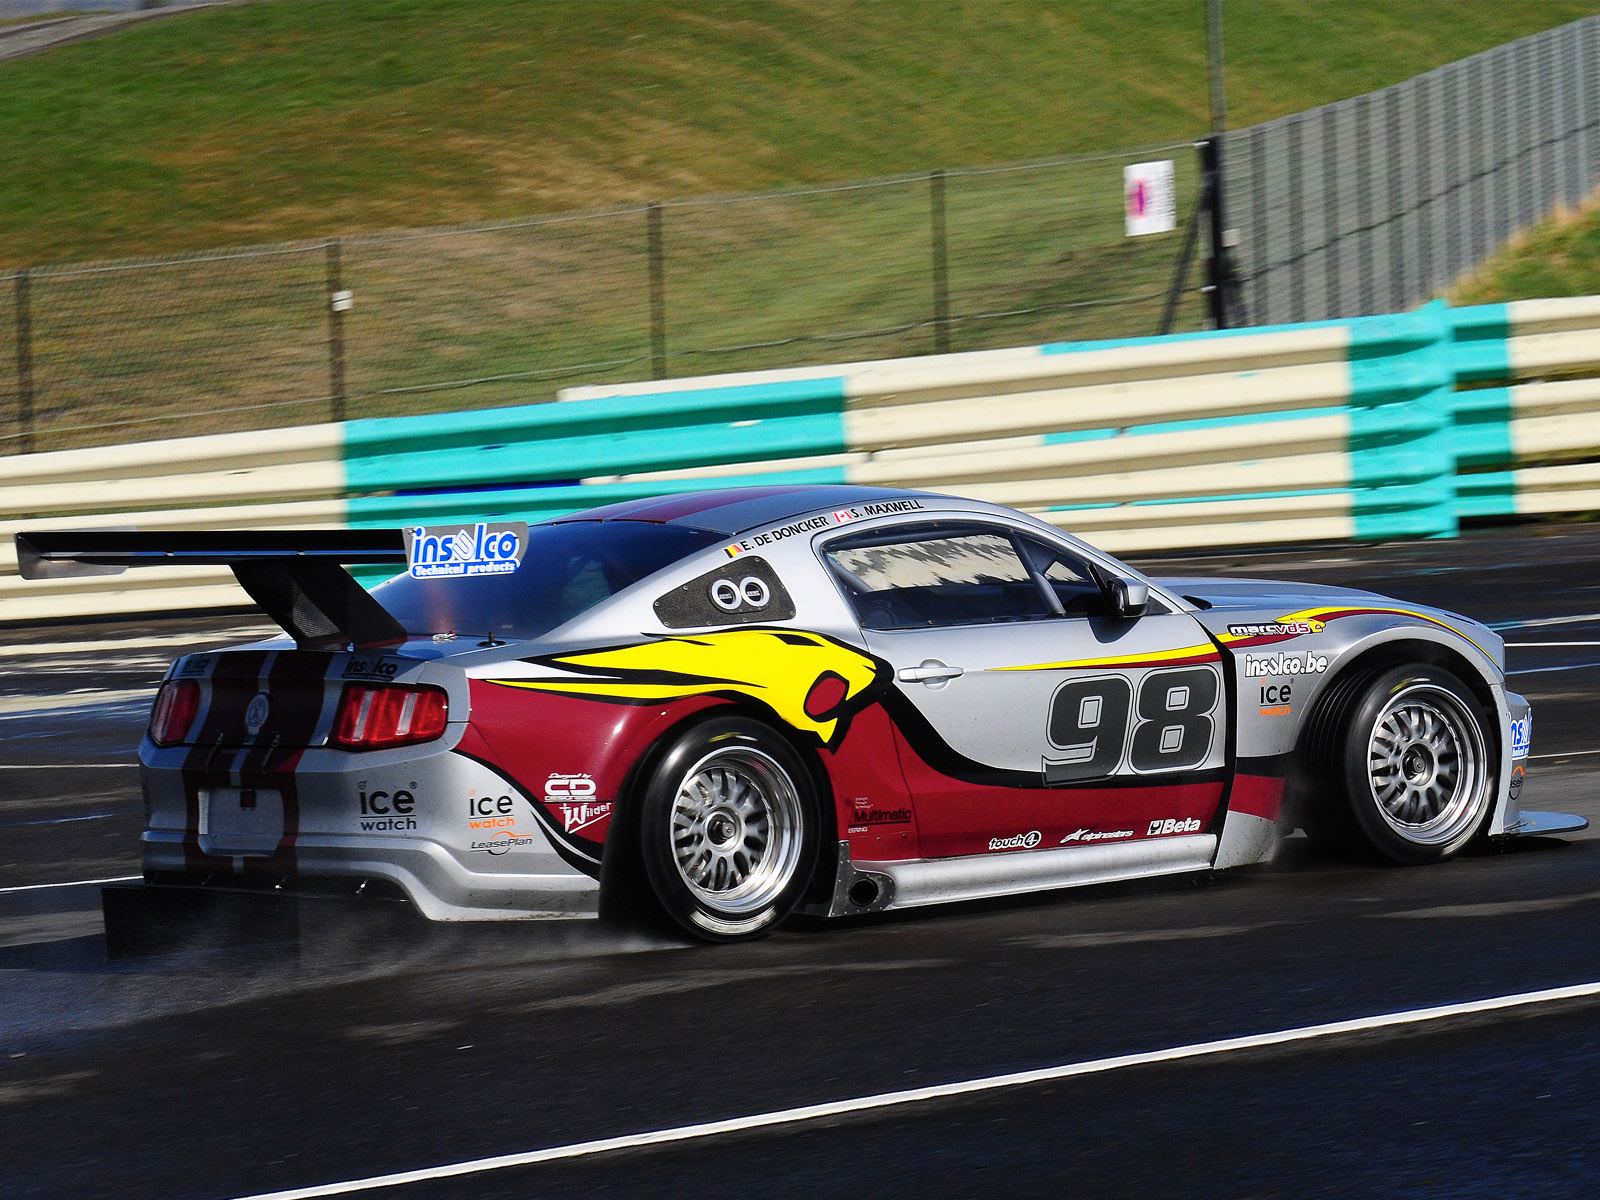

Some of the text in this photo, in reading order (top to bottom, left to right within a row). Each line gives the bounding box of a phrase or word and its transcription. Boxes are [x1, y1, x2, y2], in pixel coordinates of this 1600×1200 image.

[851, 499, 925, 518] S. MAXWELL
[740, 515, 830, 551] E. DE DONCKER
[414, 561, 516, 576] Technical products
[1260, 678, 1292, 704] ice
[1260, 705, 1291, 717] watch
[1041, 664, 1221, 787] 98
[359, 781, 416, 815] ice
[468, 790, 513, 816] ice
[469, 817, 515, 829] watch
[854, 808, 912, 822] Multimatic
[360, 817, 417, 831] watch
[1162, 817, 1201, 833] Beta
[470, 838, 533, 850] LeasePlan
